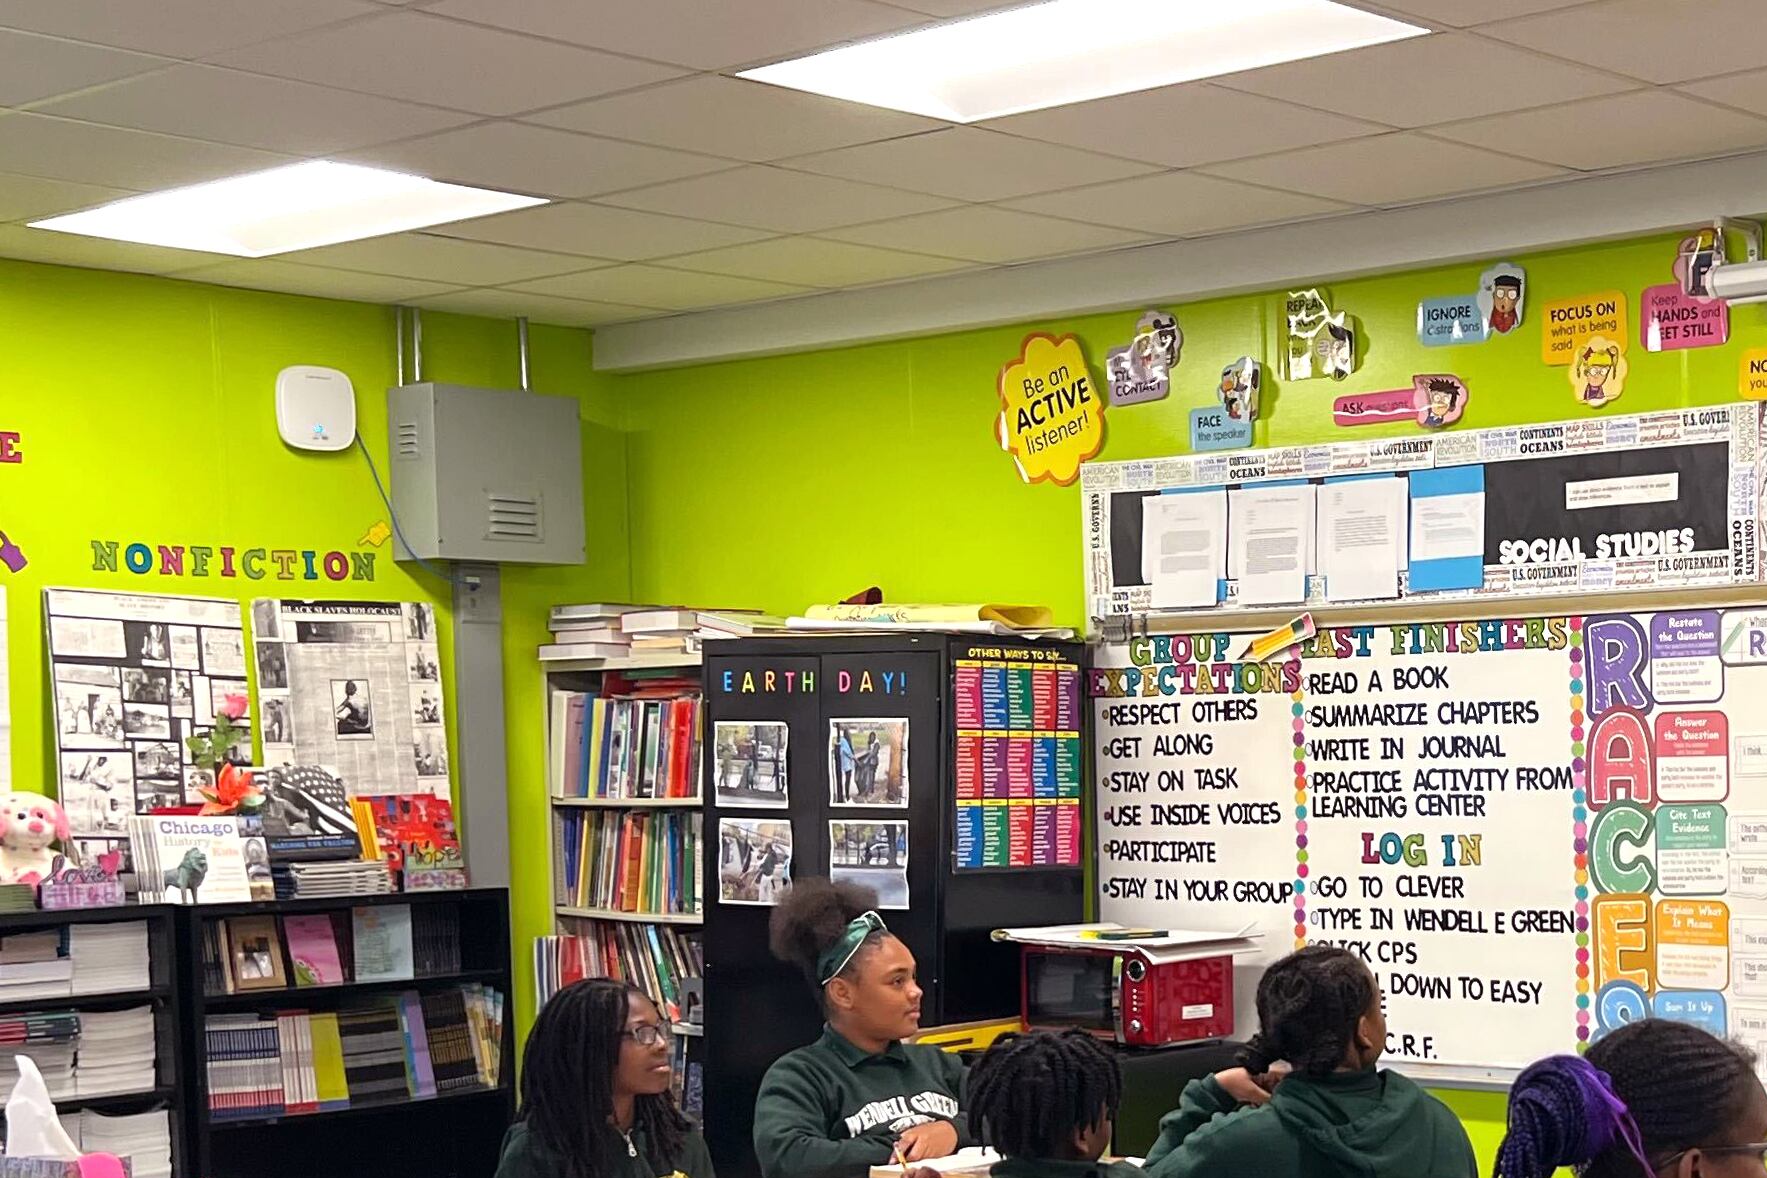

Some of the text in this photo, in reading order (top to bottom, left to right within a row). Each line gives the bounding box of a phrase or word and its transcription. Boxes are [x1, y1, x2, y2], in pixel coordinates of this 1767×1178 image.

[1427, 306, 1471, 322] IGNORE
[1551, 301, 1615, 322] FOCUS ON
[1652, 307, 1720, 322] HANDS and
[1552, 319, 1617, 337] what is being
[1682, 322, 1713, 338] STILL
[1552, 340, 1573, 352] said
[1024, 365, 1070, 399] Be an
[1017, 378, 1091, 434] ACTIVE
[1025, 410, 1089, 456] listener!
[1197, 414, 1221, 429] FACE
[1519, 426, 1564, 440] CONTINENTS
[1519, 440, 1564, 454] OCEANS
[1499, 527, 1695, 565] SOCIAL STUDIES
[91, 540, 376, 582] NONFICTION
[1658, 555, 1729, 572] U.S. GOVERNMENT
[1391, 617, 1567, 655] FINISHERS
[1003, 649, 1028, 660] WAYS
[1032, 650, 1044, 660] TO
[1129, 633, 1230, 667] GROUP
[723, 670, 908, 696] EARTH DAY!
[1087, 658, 1302, 697] EXPECTATIONS
[1310, 666, 1449, 695] READ A BOOK
[1109, 699, 1258, 726] RESPECT OTHERS
[1312, 701, 1539, 728] SUMMARIZE CHAPTERS
[1109, 733, 1213, 759] GET ALONG
[1312, 735, 1506, 761] WRITE IN JOURNAL
[1110, 768, 1238, 792] STAY ON TASK
[1313, 767, 1574, 794] PRACTICE ACTIVITY FROM
[1110, 802, 1281, 826] USE INSIDE VOICES
[1312, 794, 1485, 818] LEARNING CENTER
[159, 820, 233, 840] Chicago
[1109, 840, 1216, 862] PARTICIPATE
[1361, 832, 1482, 867] LOG IN
[1109, 878, 1294, 904] STAY IN YOUR GROUP
[1318, 875, 1464, 898] GO TO CLEVER
[1318, 908, 1575, 934] TYPE IN WENDELL E GREEN
[1377, 941, 1418, 964] CPS
[1391, 972, 1543, 1005] DOWN TO EASY
[844, 1096, 915, 1138] WENDELL
